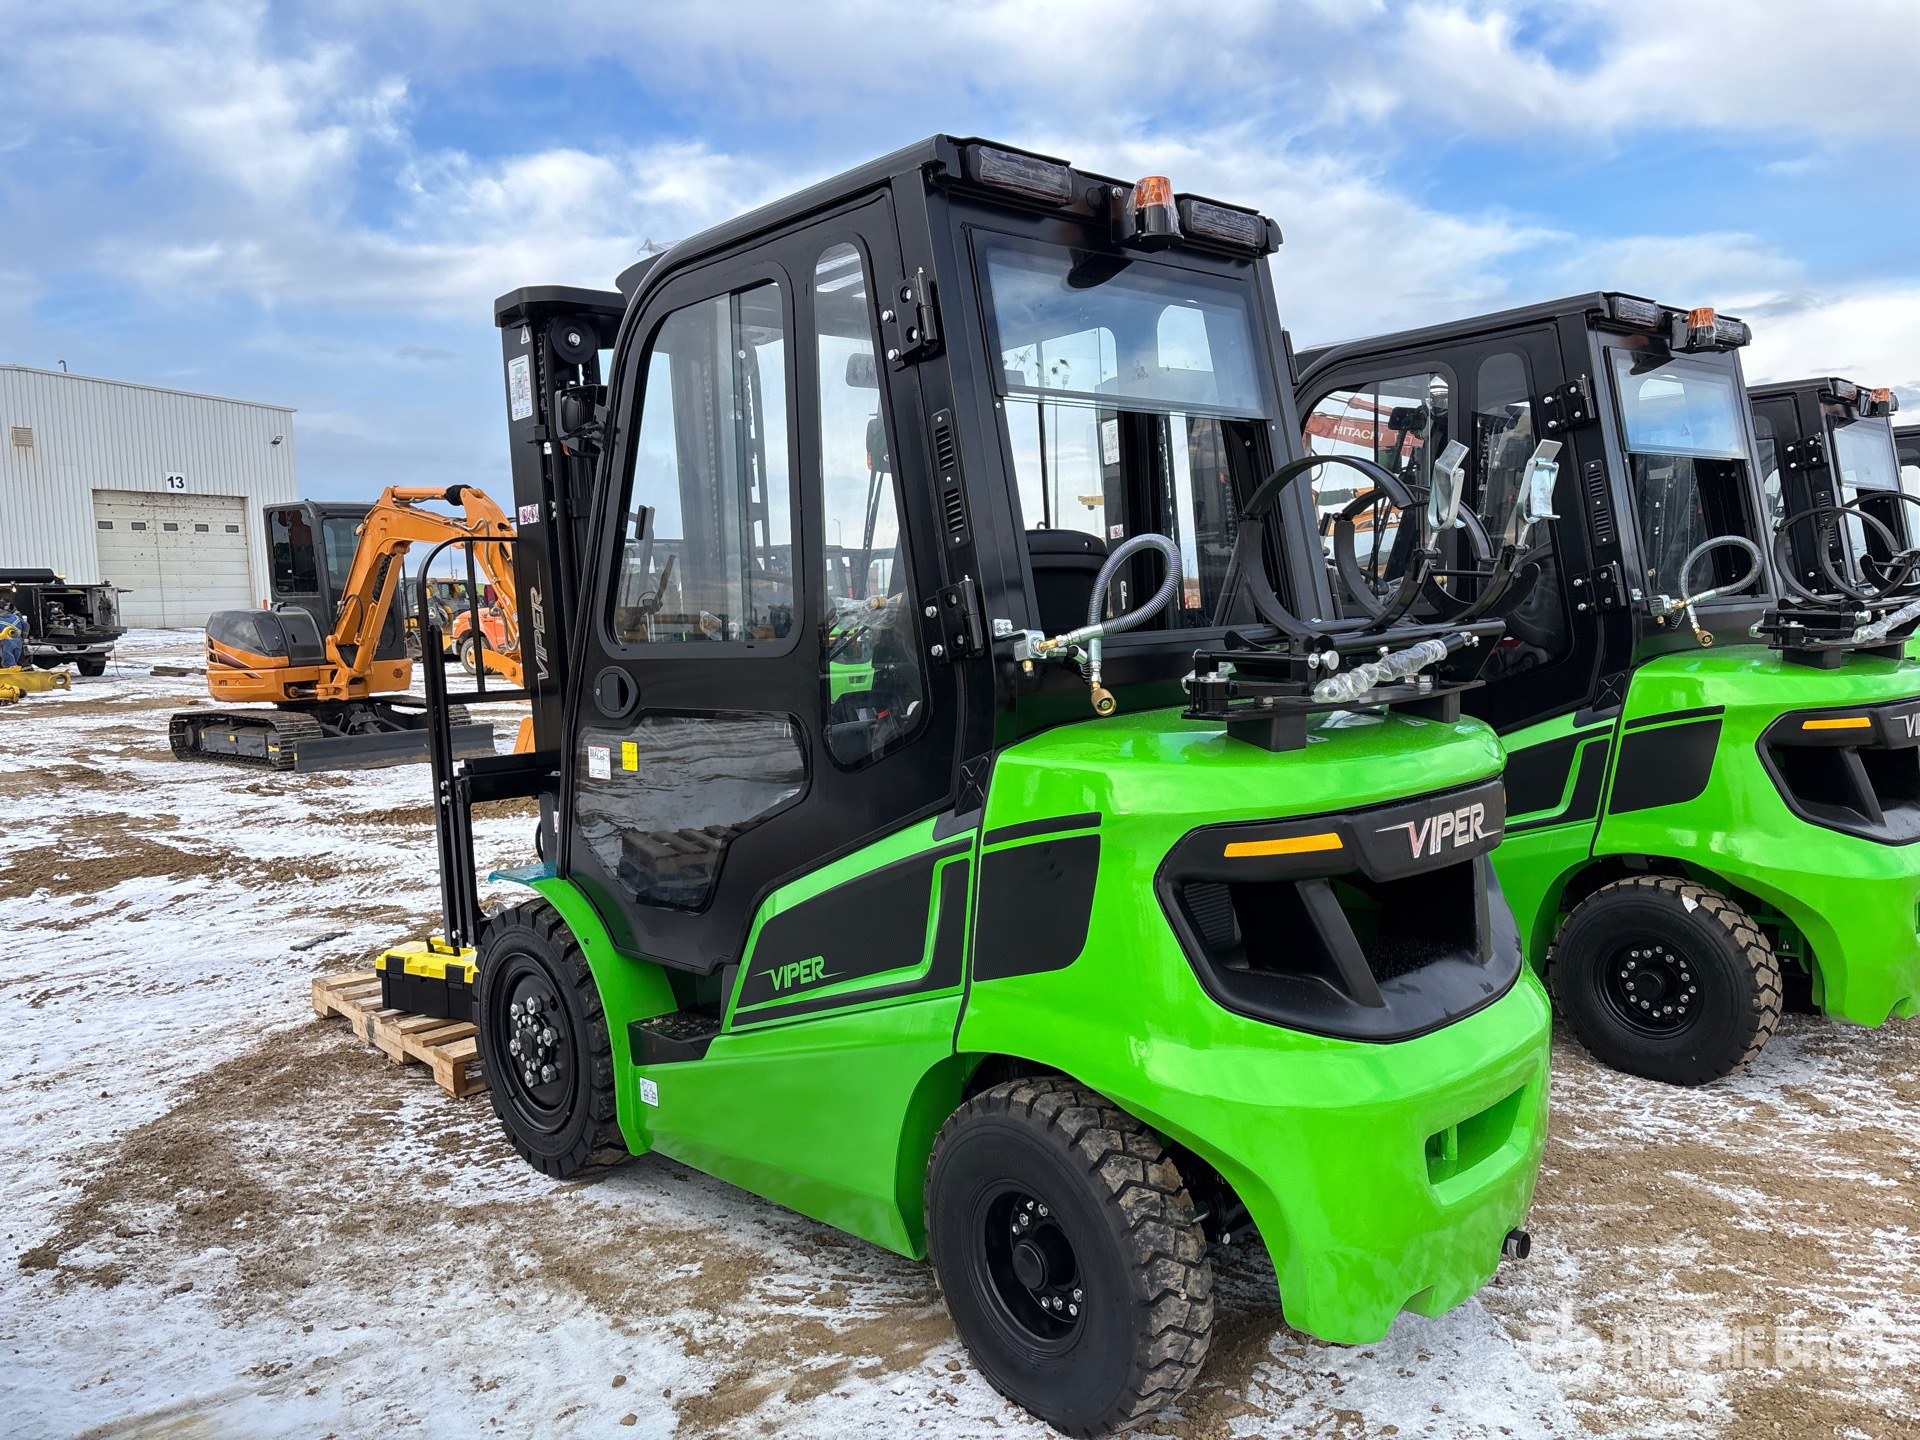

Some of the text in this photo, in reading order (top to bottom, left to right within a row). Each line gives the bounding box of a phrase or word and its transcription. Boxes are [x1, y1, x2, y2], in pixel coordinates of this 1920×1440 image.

[167, 475, 185, 489] 13
[530, 561, 549, 711] VIPER
[1374, 802, 1501, 859] VIPER
[752, 955, 847, 991] VIPER
